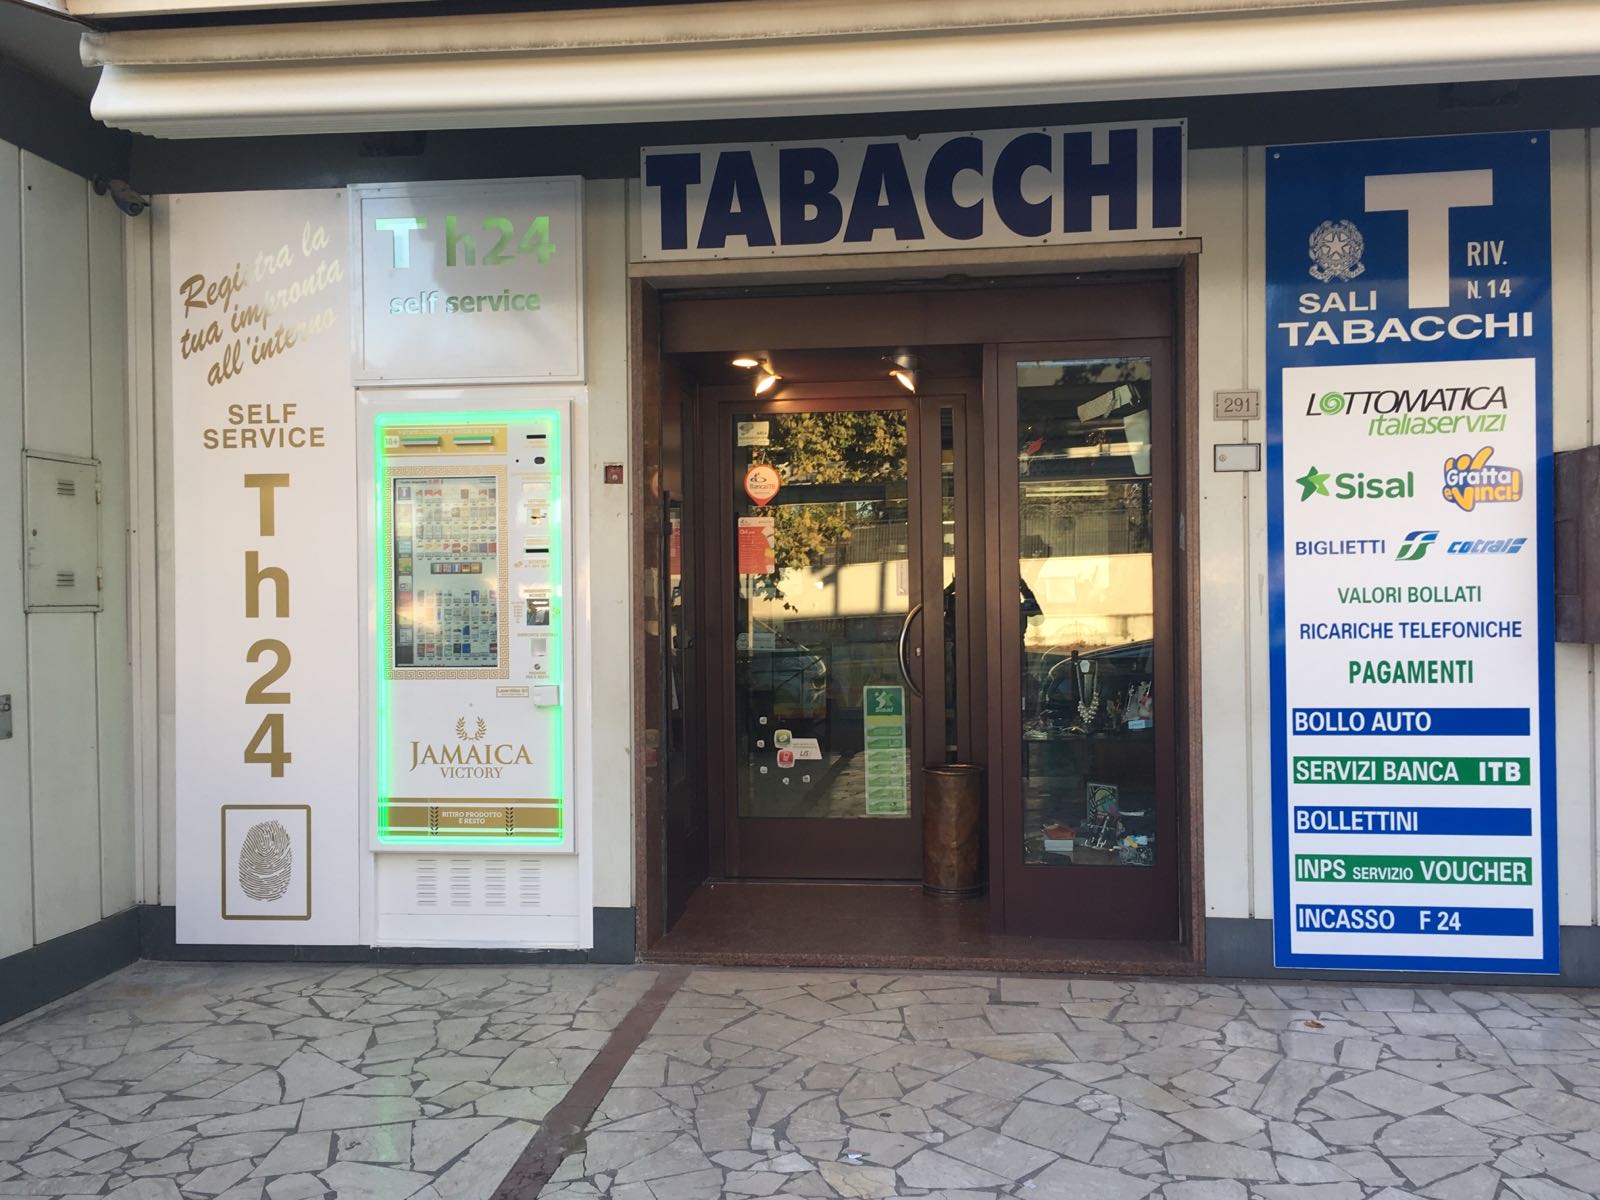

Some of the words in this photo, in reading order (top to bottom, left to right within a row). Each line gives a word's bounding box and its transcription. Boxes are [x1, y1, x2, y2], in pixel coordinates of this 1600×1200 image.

[645, 126, 1182, 250] TABACCHI
[302, 220, 329, 256] la
[446, 215, 556, 266] h24
[1365, 169, 1493, 309] T
[1467, 240, 1507, 266] RIV.
[1488, 278, 1512, 298] 14
[180, 320, 223, 360] tua
[231, 258, 343, 330] impronta
[389, 290, 438, 314] self
[446, 288, 541, 313] service
[1298, 290, 1377, 315] SALI
[1278, 311, 1533, 347] TABACCHI
[207, 306, 336, 387] all'interno
[1223, 397, 1250, 413] 291
[1305, 386, 1508, 416] LOTTOMATICA
[228, 403, 297, 425] SELF
[1368, 413, 1508, 437] italiaservizi
[203, 426, 325, 450] SERVICE
[1335, 470, 1415, 500] Sisal
[1446, 467, 1513, 486] Gratta
[1295, 539, 1386, 556] BIGLIETTI
[1446, 538, 1510, 554] cotral
[1337, 587, 1402, 604] VALORI
[1408, 586, 1481, 602] BOLLATI
[1300, 622, 1394, 640] RICARICHE
[1398, 621, 1522, 639] TELEFONICHE
[1349, 660, 1473, 684] PAGAMENTI
[1295, 711, 1365, 732] BOLLO
[1371, 711, 1432, 732] AUTO
[409, 741, 533, 772] JAMAICA
[440, 766, 503, 779] VICTORY
[1296, 760, 1376, 781] SERVIZI
[1383, 761, 1459, 782] BANCA
[1479, 761, 1521, 782] ITB
[1296, 810, 1418, 832] BOLLETTINI
[1297, 858, 1346, 880] INPS
[1352, 866, 1414, 881] SERVIZIO
[1420, 860, 1527, 883] VOUCHER
[1299, 908, 1395, 930] INCASSO
[1419, 910, 1431, 931] F
[1437, 912, 1462, 931] 24
